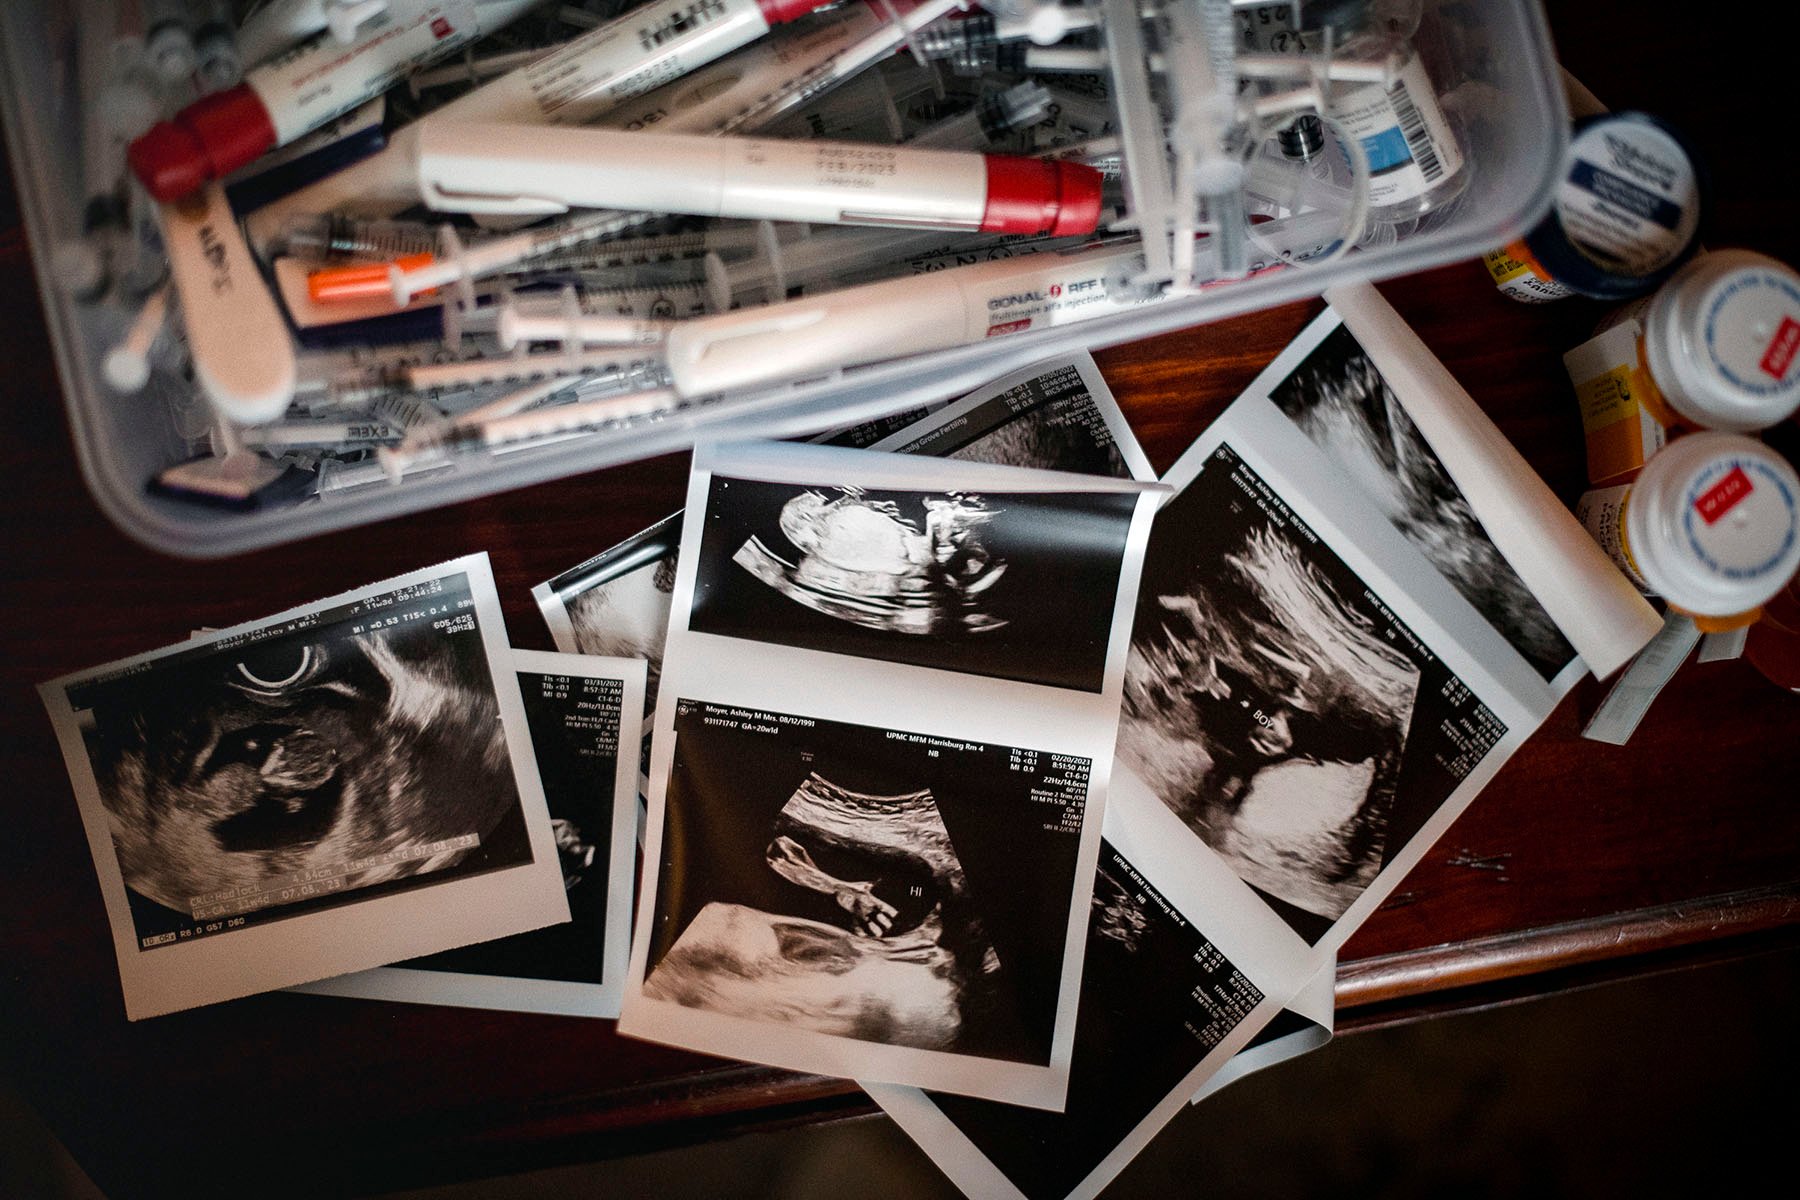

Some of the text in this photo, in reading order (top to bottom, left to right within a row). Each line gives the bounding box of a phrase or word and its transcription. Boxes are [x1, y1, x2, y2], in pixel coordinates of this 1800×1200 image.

[920, 431, 941, 445] Grove
[940, 417, 968, 436] Fertility
[429, 604, 448, 616] 0.4
[288, 623, 296, 632] M
[433, 613, 473, 630] 605/625
[584, 679, 622, 688] 03/31/2023
[705, 705, 815, 728] Moyer, Ashley M Mrs. 08/12/1991
[1253, 709, 1274, 729] BOY
[704, 717, 778, 734] 931171747 GA=20w1d
[886, 731, 908, 741] UPMC
[909, 735, 927, 744] MFM
[928, 738, 964, 751] Harrisburg
[965, 743, 977, 751] Rm
[928, 749, 939, 758] NB
[1051, 754, 1091, 765] 02/20/2023
[1010, 763, 1089, 780] MI 0.9 C1-6-D
[1052, 761, 1076, 771] 8:51:50
[1077, 765, 1090, 773] AM
[910, 886, 923, 897] HI
[1113, 854, 1131, 872] UPMC
[1129, 871, 1145, 886] MFM
[1143, 884, 1171, 914] Harrisburg
[1170, 910, 1180, 922] Rm
[1136, 893, 1147, 904] NB
[1232, 970, 1263, 1000] 02/20/2023
[1247, 995, 1257, 1006] AM
